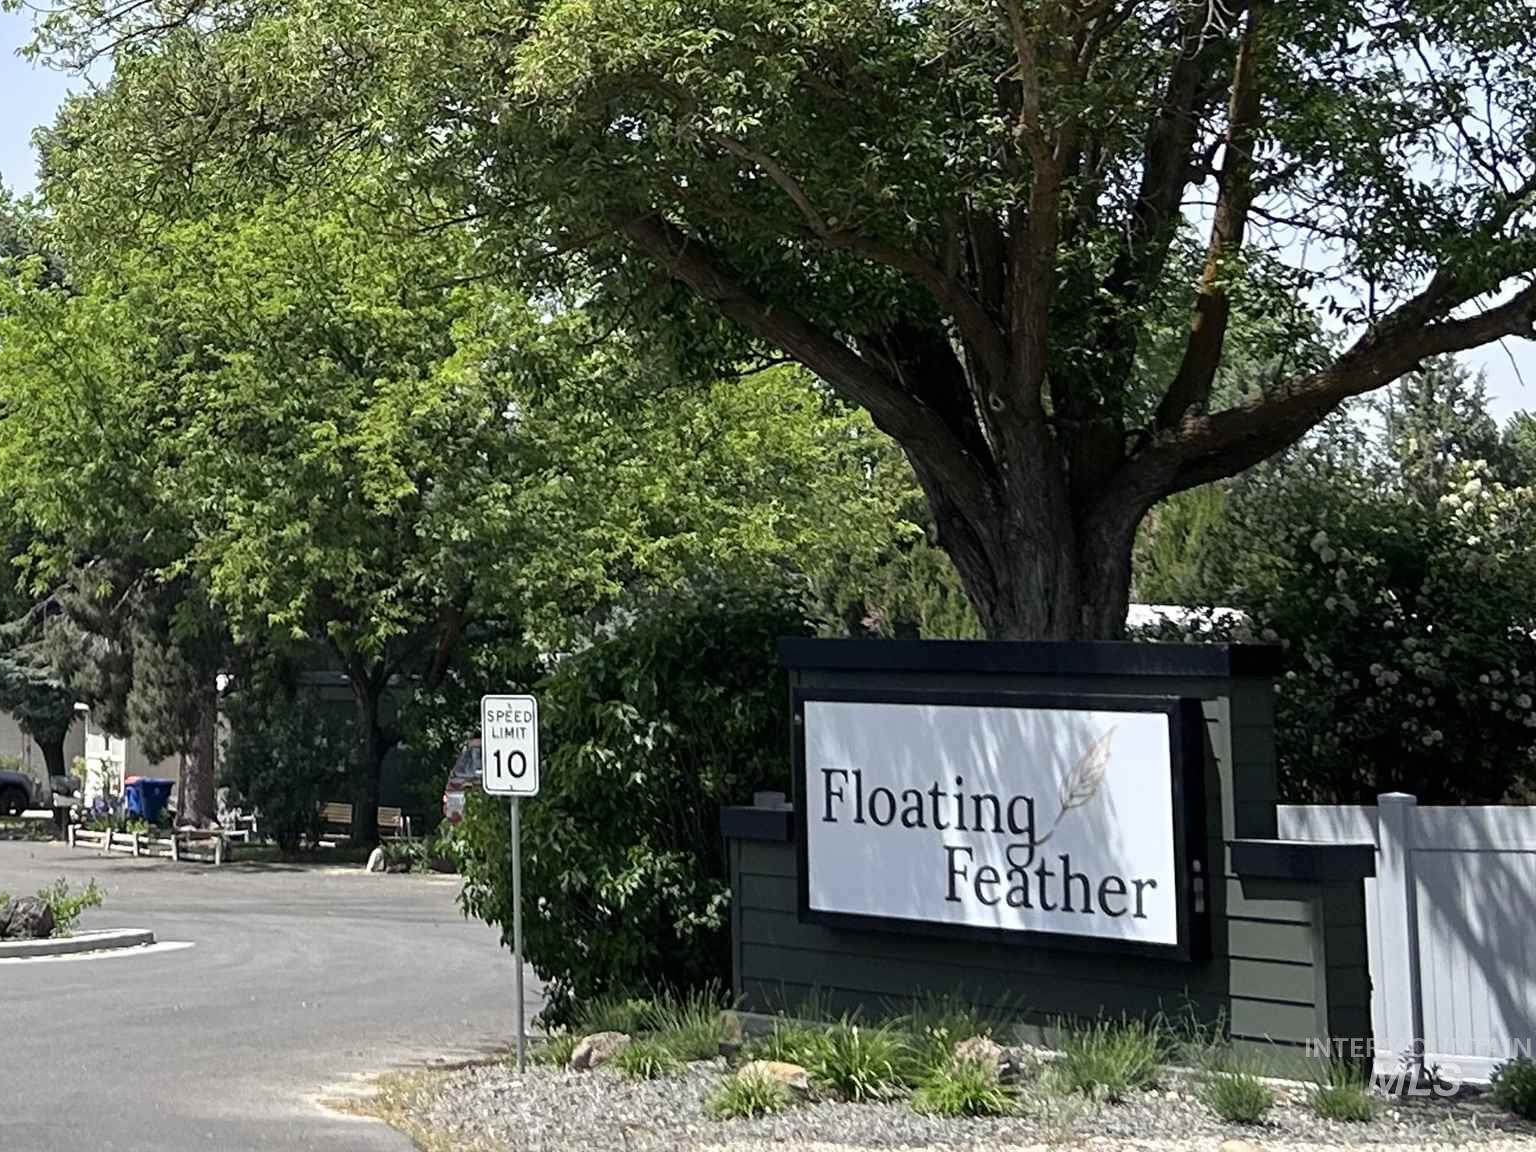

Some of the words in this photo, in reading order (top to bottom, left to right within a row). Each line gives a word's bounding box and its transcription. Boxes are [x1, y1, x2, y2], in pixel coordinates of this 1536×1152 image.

[487, 710, 532, 723] SPEED
[491, 727, 527, 739] LIMIT
[493, 749, 527, 778] 10
[820, 767, 1036, 871] Floating
[943, 844, 1157, 919] Feather
